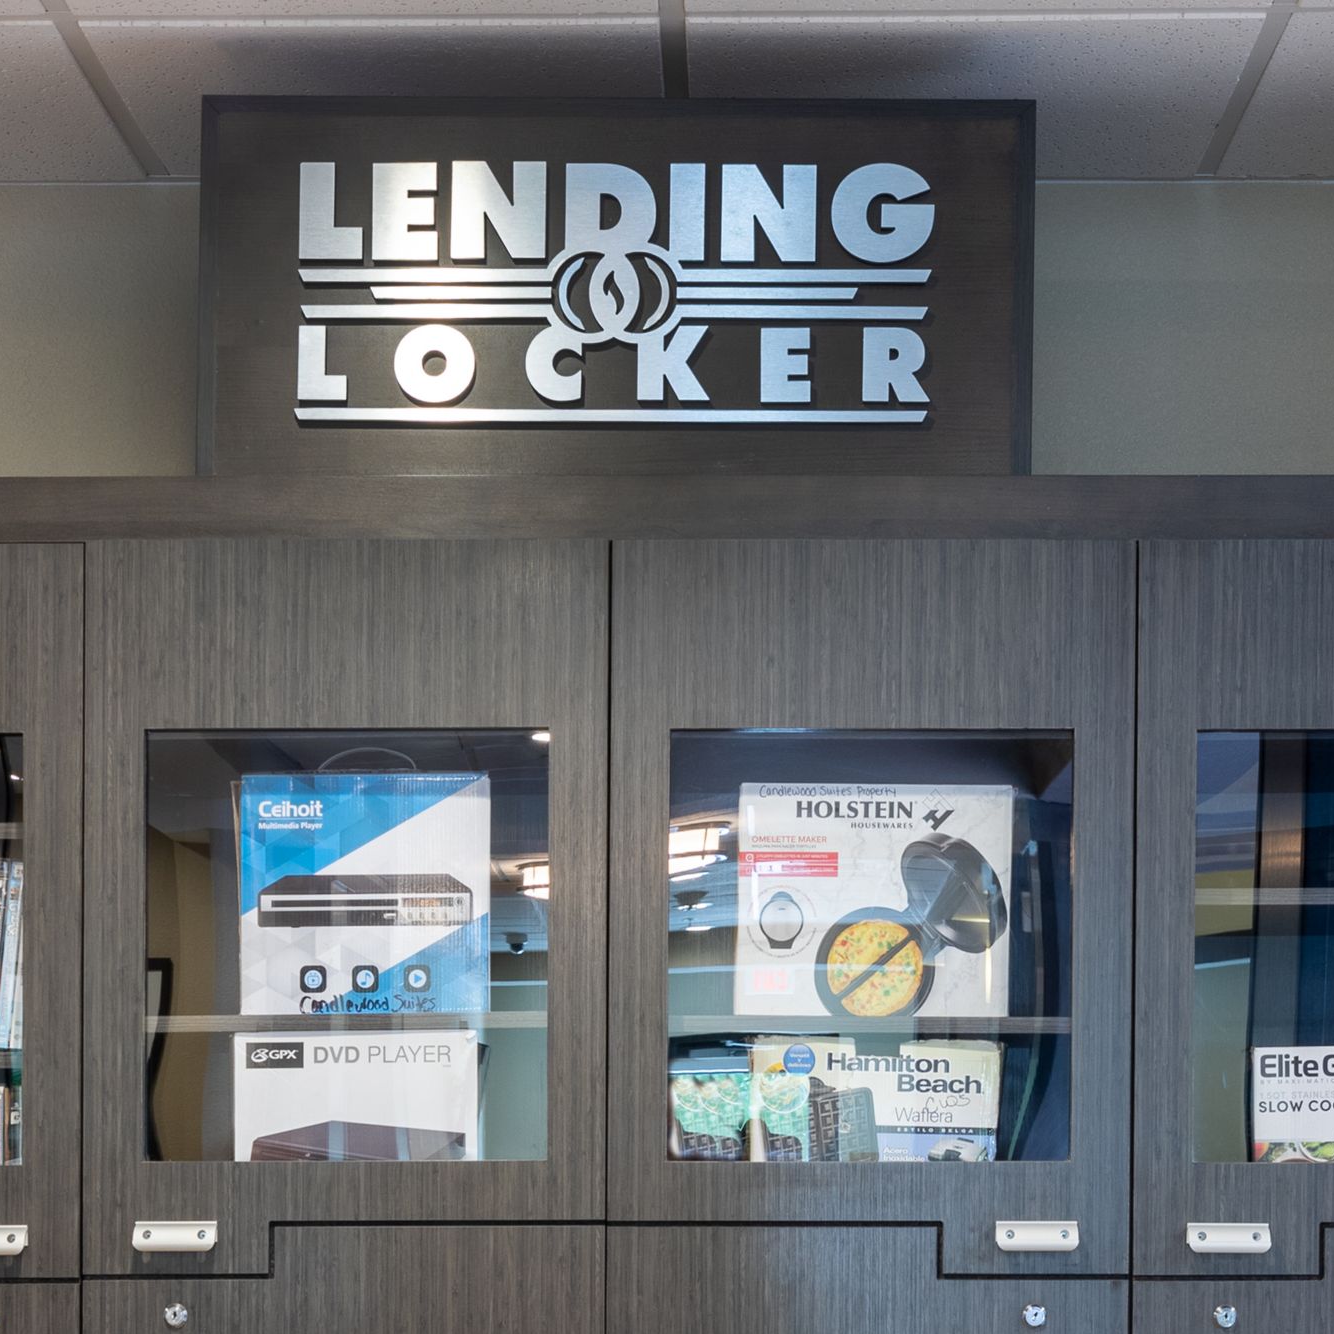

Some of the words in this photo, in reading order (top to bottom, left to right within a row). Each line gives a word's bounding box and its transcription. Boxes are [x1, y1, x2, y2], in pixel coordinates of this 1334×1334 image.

[298, 161, 936, 264] LENDING
[297, 323, 931, 404] LOCKER
[759, 785, 817, 798] Candlewood
[818, 785, 853, 797] Suites
[857, 785, 898, 799] Property
[258, 800, 323, 818] Ceihoit
[795, 801, 914, 819] HOLSTEIN
[258, 822, 299, 830] Multimedia
[300, 821, 323, 831] Player
[751, 835, 797, 844] OMELETTE
[798, 835, 827, 844] MAKER
[299, 995, 390, 1014] Candlewood
[391, 994, 437, 1013] Suites
[313, 1046, 360, 1064] DVD
[367, 1045, 452, 1064] PLAYER
[827, 1052, 950, 1073] Hamilton
[1260, 1054, 1319, 1078] Elite
[897, 1074, 982, 1096] Beach
[1258, 1101, 1303, 1113] SLOW
